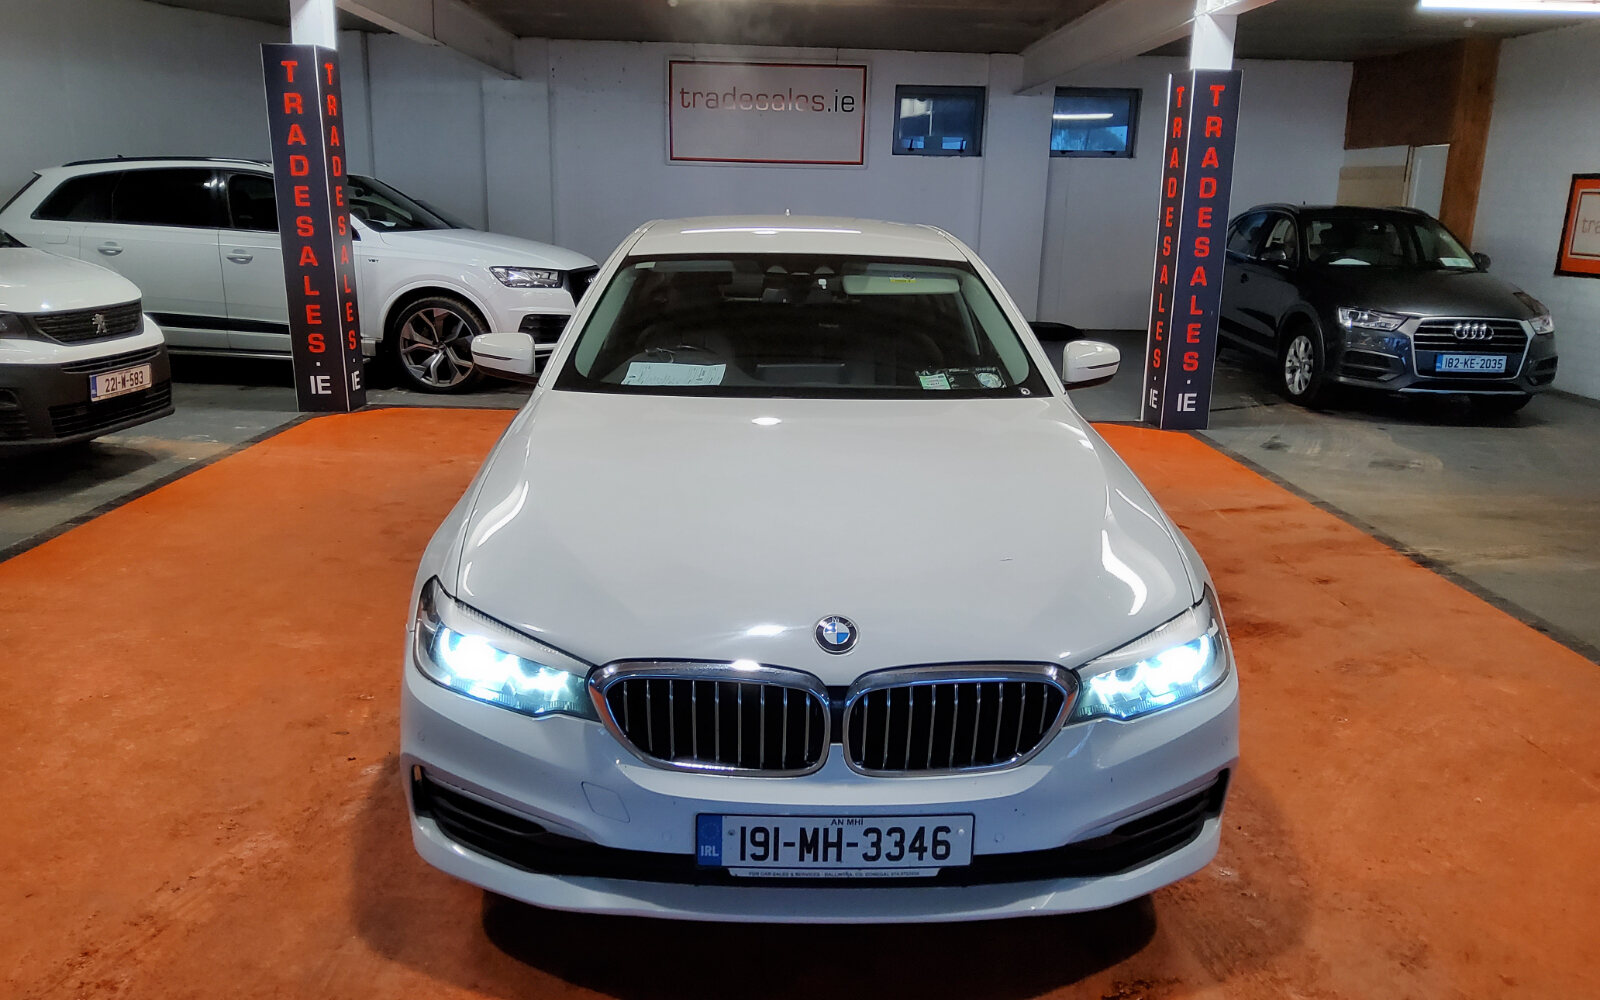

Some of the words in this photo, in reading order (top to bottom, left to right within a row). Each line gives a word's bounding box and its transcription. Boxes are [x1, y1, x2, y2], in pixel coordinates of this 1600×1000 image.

[680, 86, 855, 112] tradesales.ie
[1444, 357, 1504, 369] 182-KE-2035
[830, 818, 844, 826] AN
[739, 826, 952, 863] 191-MH-3346
[700, 845, 720, 857] IRL
